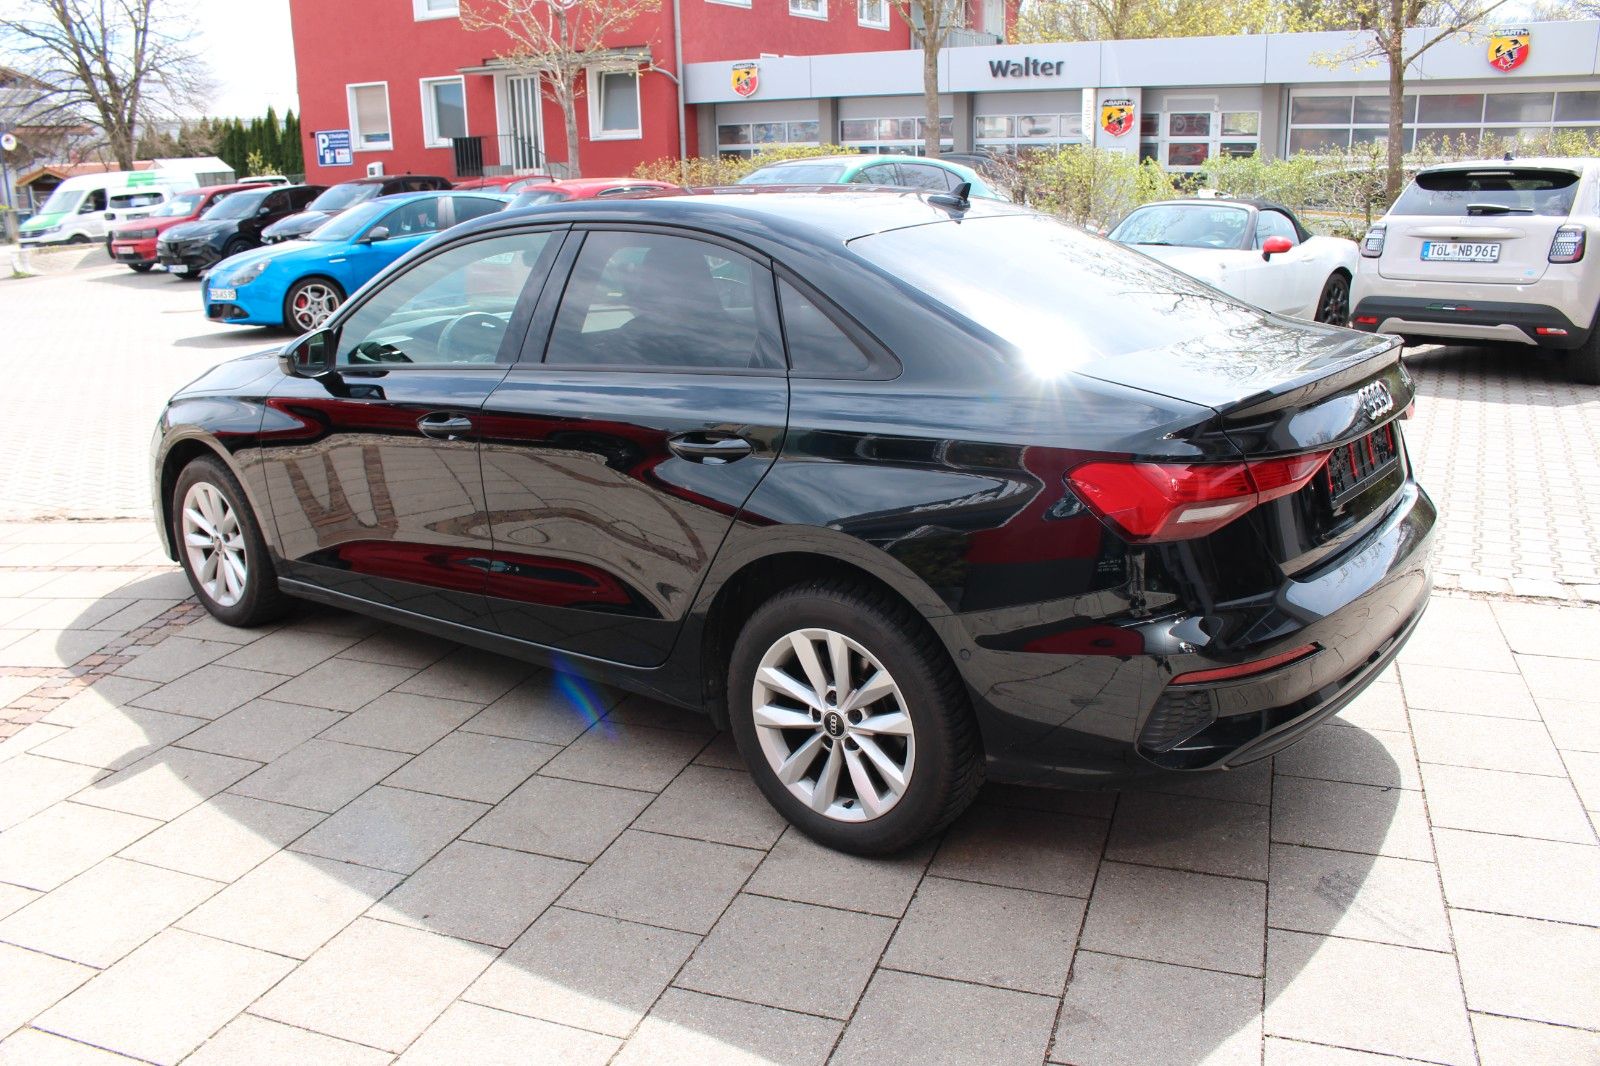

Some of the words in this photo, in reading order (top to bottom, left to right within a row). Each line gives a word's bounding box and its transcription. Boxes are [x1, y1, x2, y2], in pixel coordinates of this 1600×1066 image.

[989, 57, 1064, 78] Walter
[318, 134, 329, 156] P
[1457, 245, 1472, 257] NB
[1475, 245, 1498, 258] 96E
